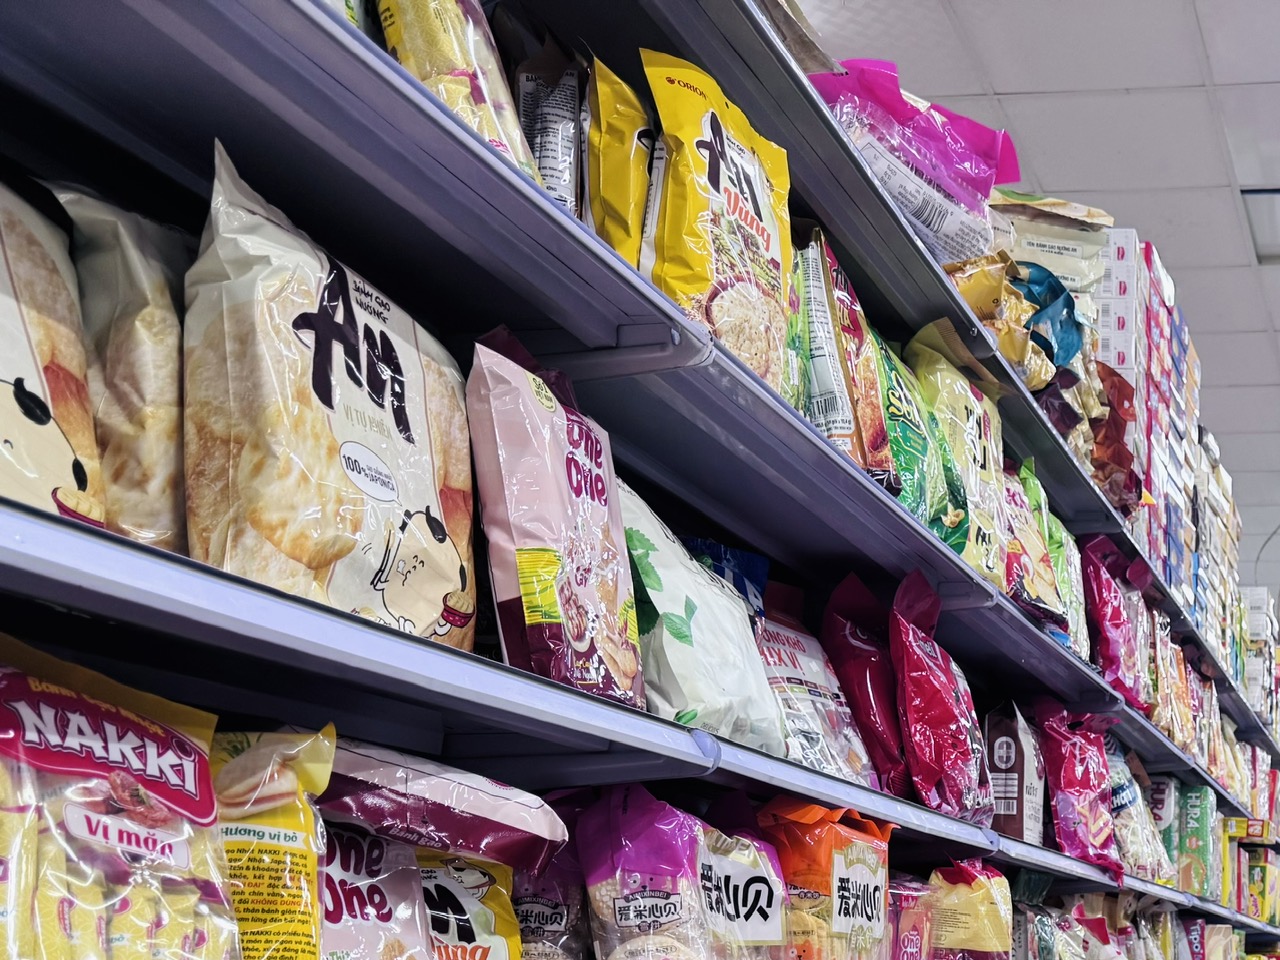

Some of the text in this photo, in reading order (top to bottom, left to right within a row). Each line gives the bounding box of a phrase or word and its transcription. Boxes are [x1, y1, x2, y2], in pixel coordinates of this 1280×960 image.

[677, 79, 708, 100] ORION
[352, 279, 373, 303] BÁNH
[355, 297, 389, 324] NƯỚNG
[292, 253, 415, 444] An
[343, 403, 367, 434] VỊ TỰ
[565, 450, 608, 507] One
[10, 700, 199, 797] NAKKI
[84, 814, 110, 849] Vị
[268, 831, 298, 844] vị bò
[324, 879, 394, 925] One
[617, 904, 677, 922] 爱米心贝
[838, 877, 881, 923] 爱米心贝
[901, 933, 920, 950] One
